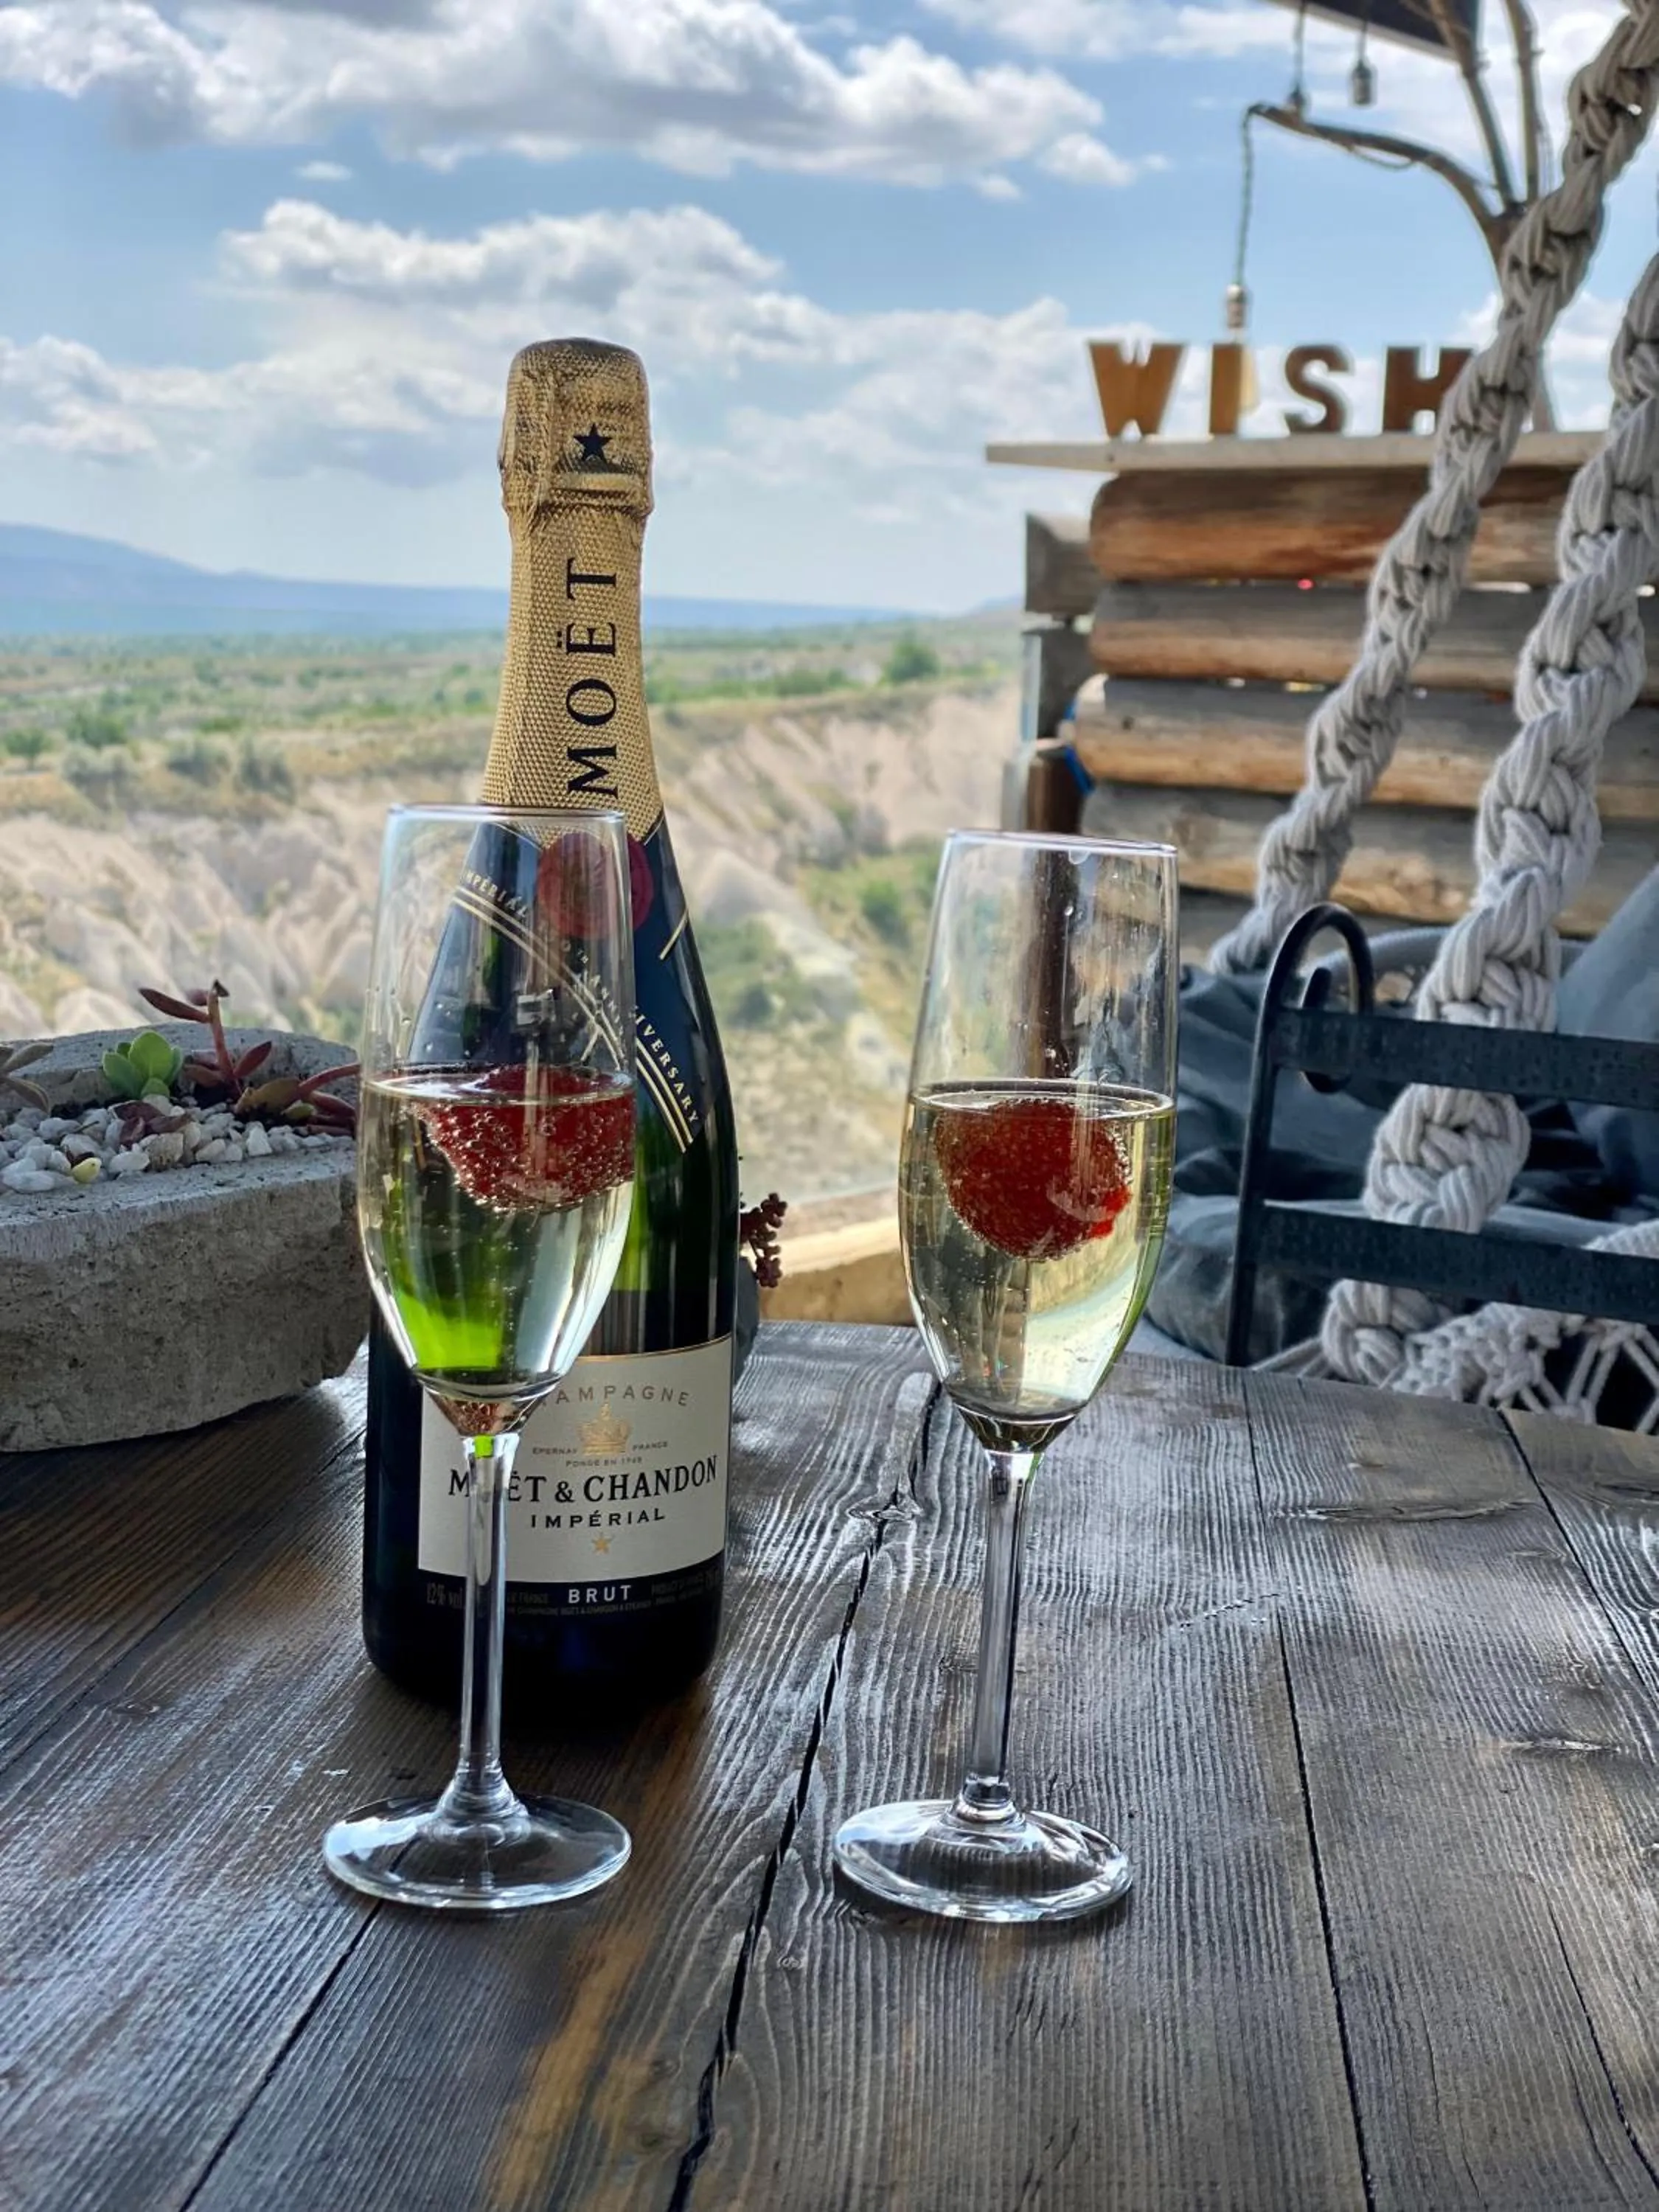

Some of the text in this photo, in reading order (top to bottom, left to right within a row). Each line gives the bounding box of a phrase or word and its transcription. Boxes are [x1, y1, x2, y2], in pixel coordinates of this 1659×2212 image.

[1088, 341, 1475, 437] WISH
[557, 557, 618, 799] MOËT
[543, 1385, 689, 1406] AMPAGNE
[448, 1455, 718, 1503] MËT & CHANDON
[531, 1506, 666, 1528] IMPÉRIAL
[568, 1585, 633, 1604] BRUT
